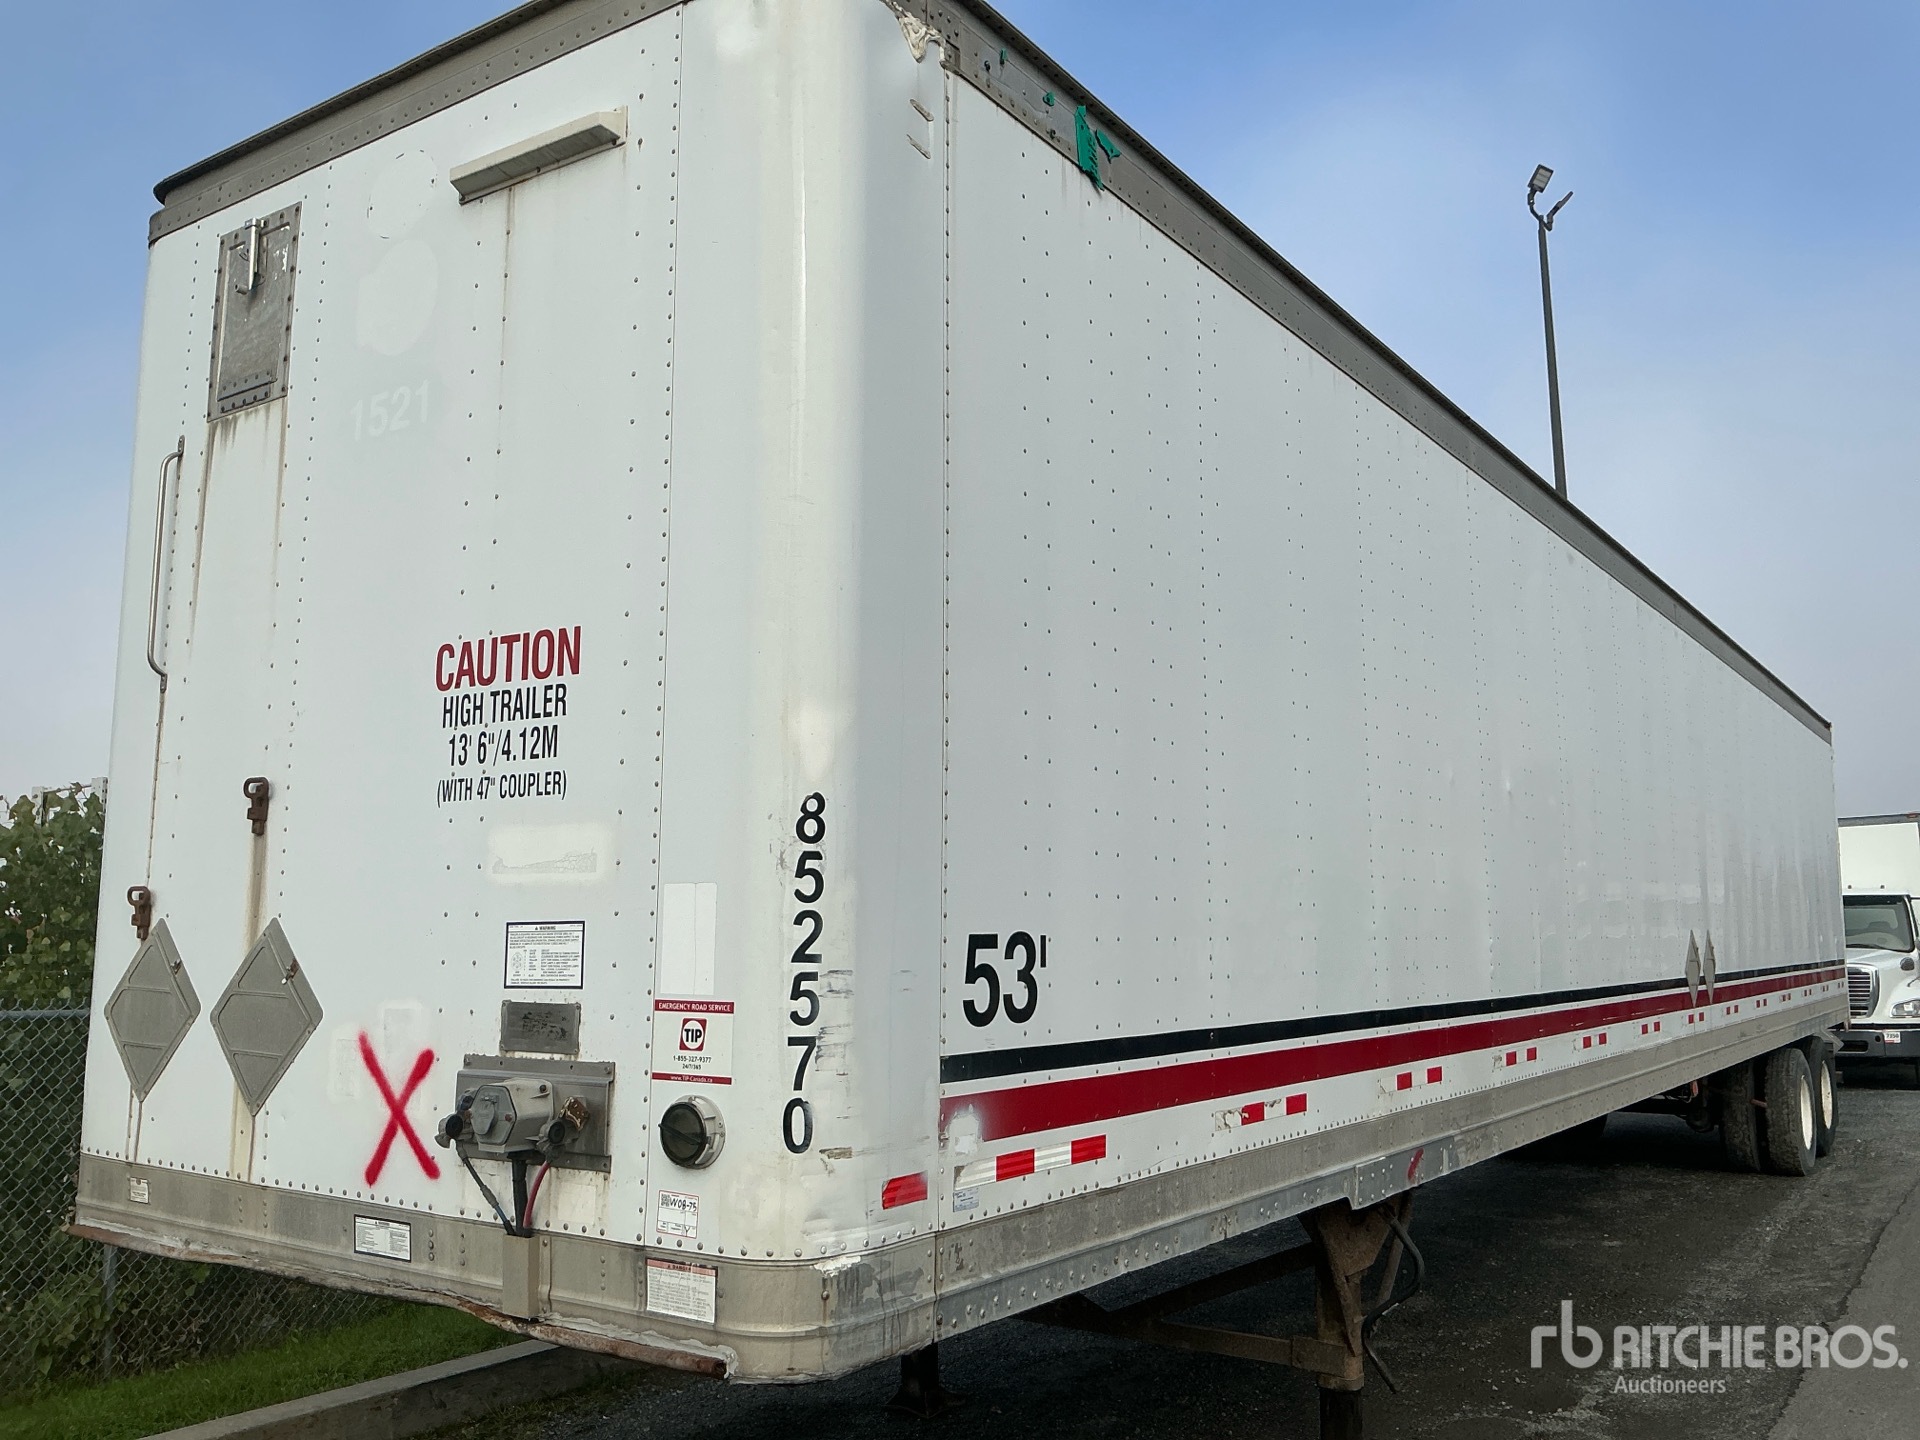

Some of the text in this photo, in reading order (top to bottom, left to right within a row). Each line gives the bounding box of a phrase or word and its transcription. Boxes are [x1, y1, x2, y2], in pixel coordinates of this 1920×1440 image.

[350, 380, 430, 441] 1521
[435, 626, 582, 691] CAUTION
[442, 683, 567, 728] HIGH TRAILER
[449, 725, 558, 766] 13' 6"/4.12M
[437, 770, 567, 808] (WITH 47" COUPLER)
[962, 931, 1047, 1027] 53'
[658, 1002, 731, 1012] EMERGENCY ROAD SERVICE
[684, 1028, 703, 1043] TIP
